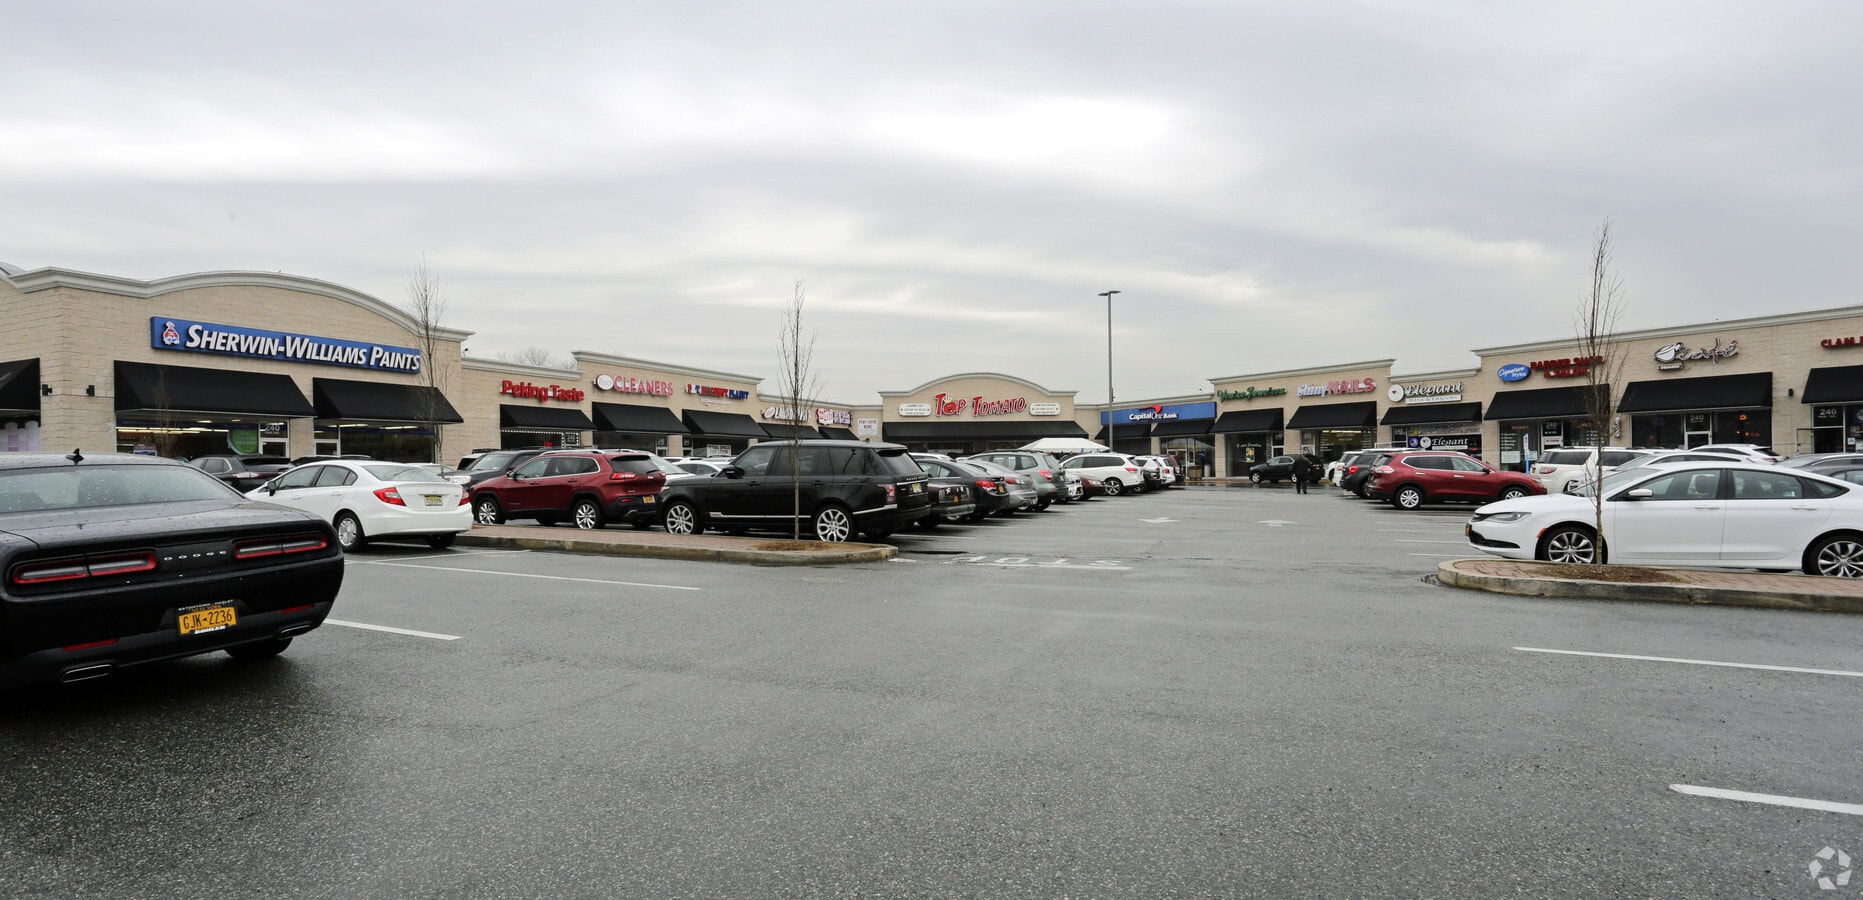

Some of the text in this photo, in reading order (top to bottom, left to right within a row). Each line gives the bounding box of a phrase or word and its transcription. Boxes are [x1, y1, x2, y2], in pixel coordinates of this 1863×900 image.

[185, 324, 420, 371] SHERWIN-WILLIAMS PAINTS
[1820, 336, 1856, 348] CLAM
[501, 379, 585, 403] Peking Taste
[613, 375, 674, 397] CLEANERS
[1328, 377, 1376, 396] NAILS
[1403, 381, 1464, 397] Elegant
[972, 396, 1027, 417] TOMATO
[1819, 408, 1837, 416] 240
[264, 424, 280, 432] 240
[163, 550, 227, 561] DODGE
